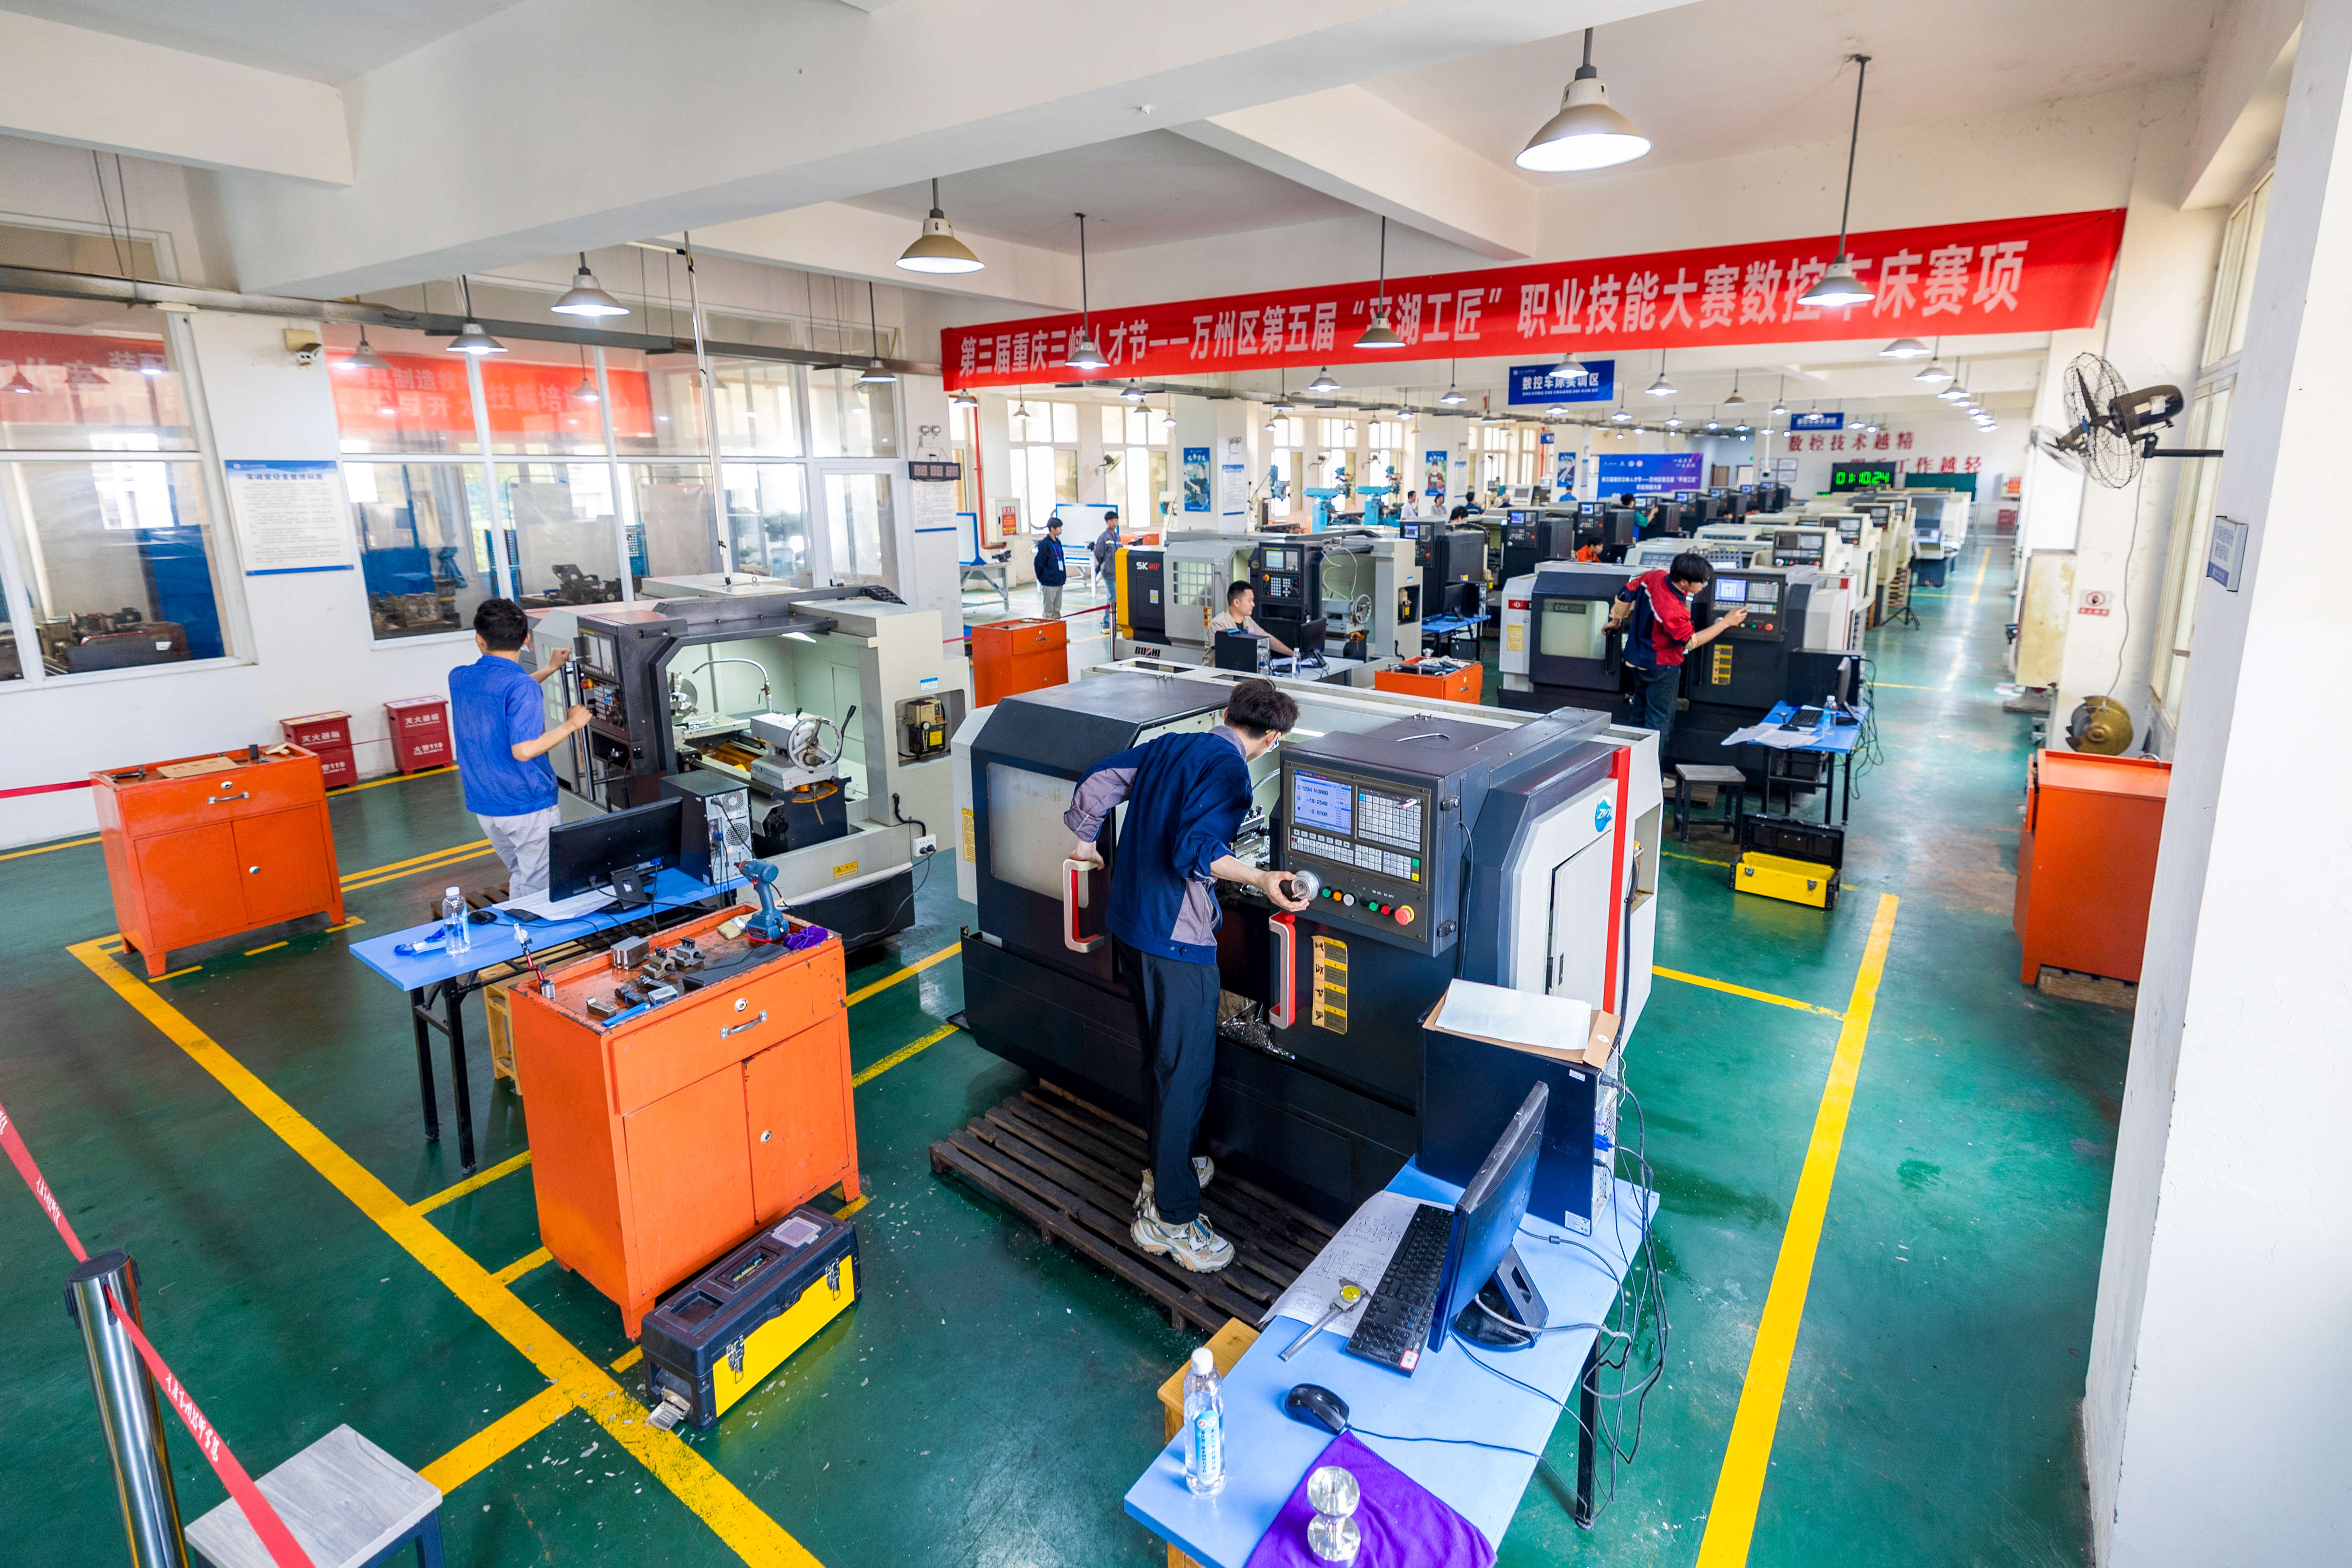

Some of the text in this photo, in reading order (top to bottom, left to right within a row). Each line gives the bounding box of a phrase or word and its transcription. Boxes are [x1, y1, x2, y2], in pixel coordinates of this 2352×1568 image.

[1788, 431, 1914, 452] 数控技术越精
